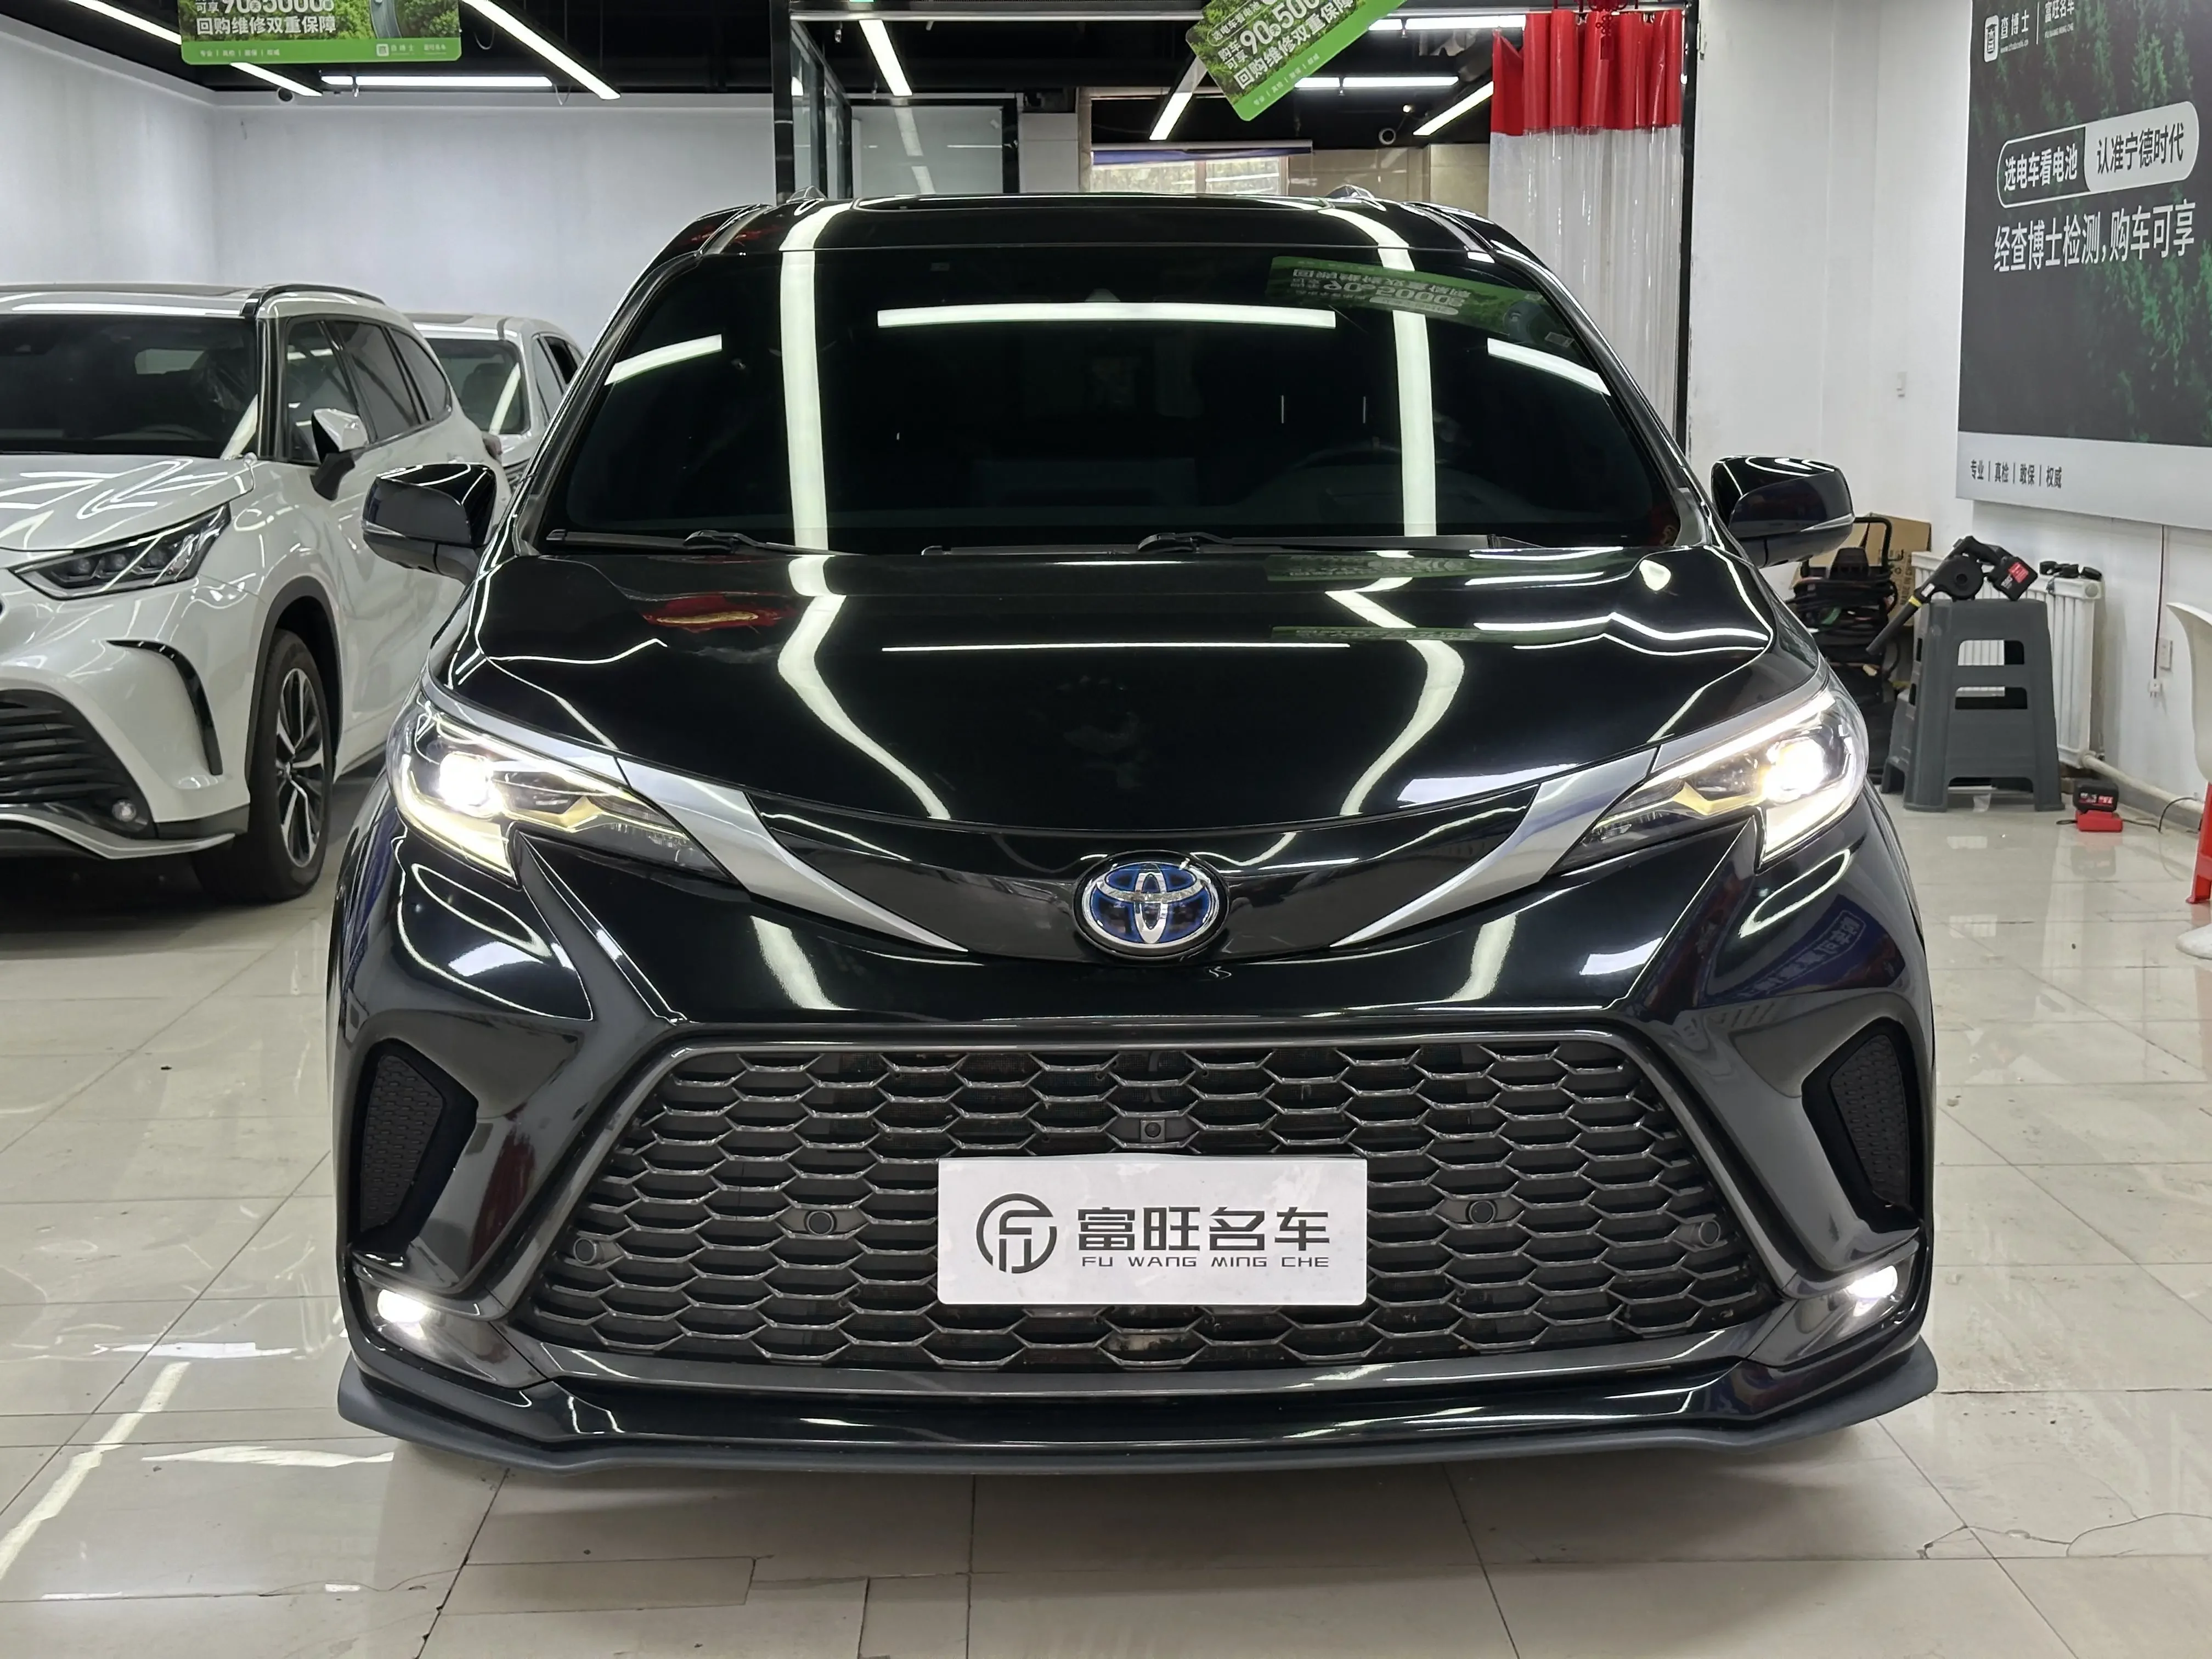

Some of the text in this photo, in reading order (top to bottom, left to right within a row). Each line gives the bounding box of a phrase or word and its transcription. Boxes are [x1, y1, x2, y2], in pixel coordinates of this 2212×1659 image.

[196, 15, 336, 35] 回购维修双重保障
[2001, 9, 2029, 39] 查博士
[2004, 122, 2184, 191] 选电车看电池 认准宁德时代
[1971, 459, 1984, 480] 专业
[1077, 1206, 1330, 1251] 富旺名车
[1082, 1256, 1329, 1267] FU WANG MING CHE
